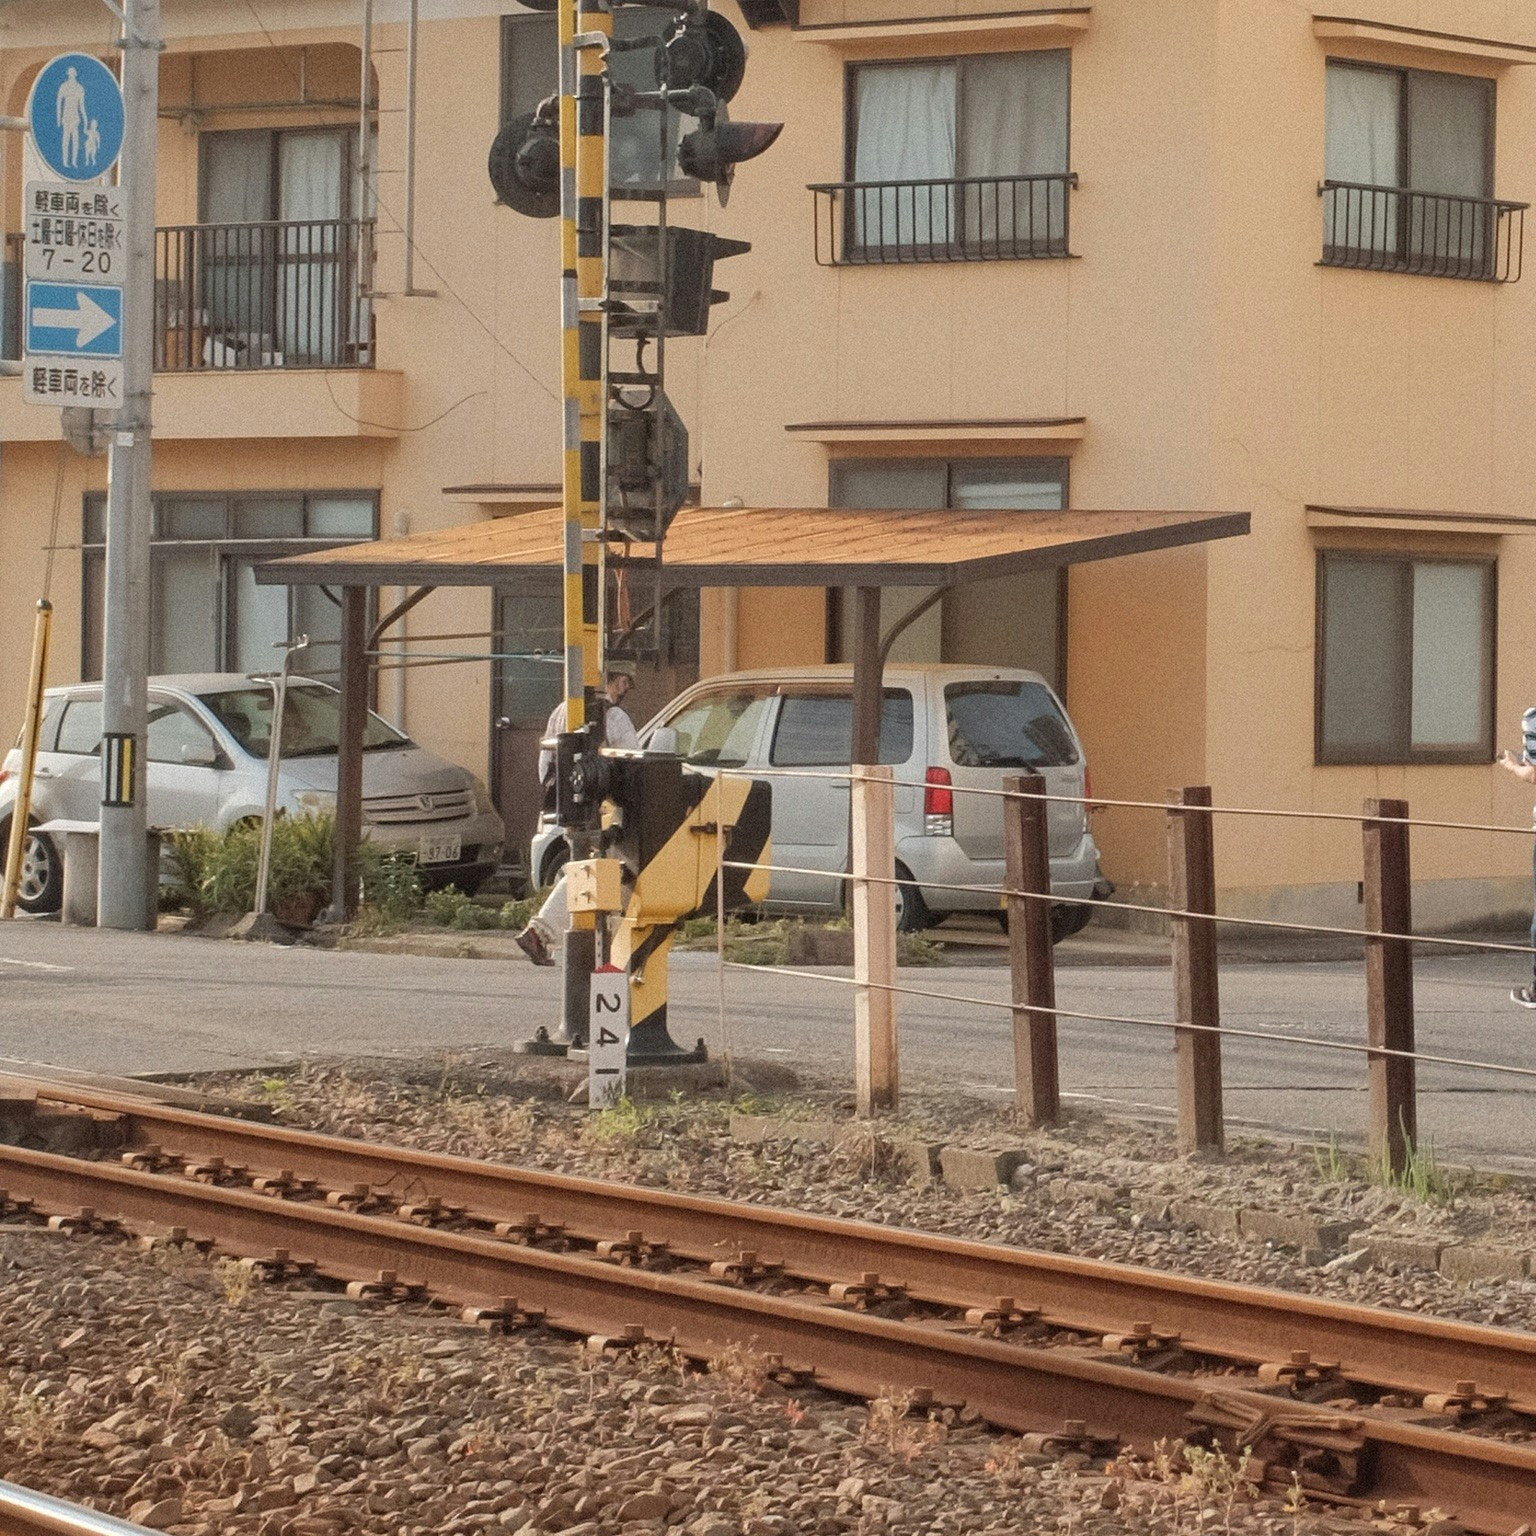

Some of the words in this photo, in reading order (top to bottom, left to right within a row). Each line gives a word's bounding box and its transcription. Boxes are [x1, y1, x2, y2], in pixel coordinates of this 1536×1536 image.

[35, 190, 120, 217] 軽車両を除く
[32, 366, 117, 398] 軽車両を除く
[595, 993, 622, 1075] 241
